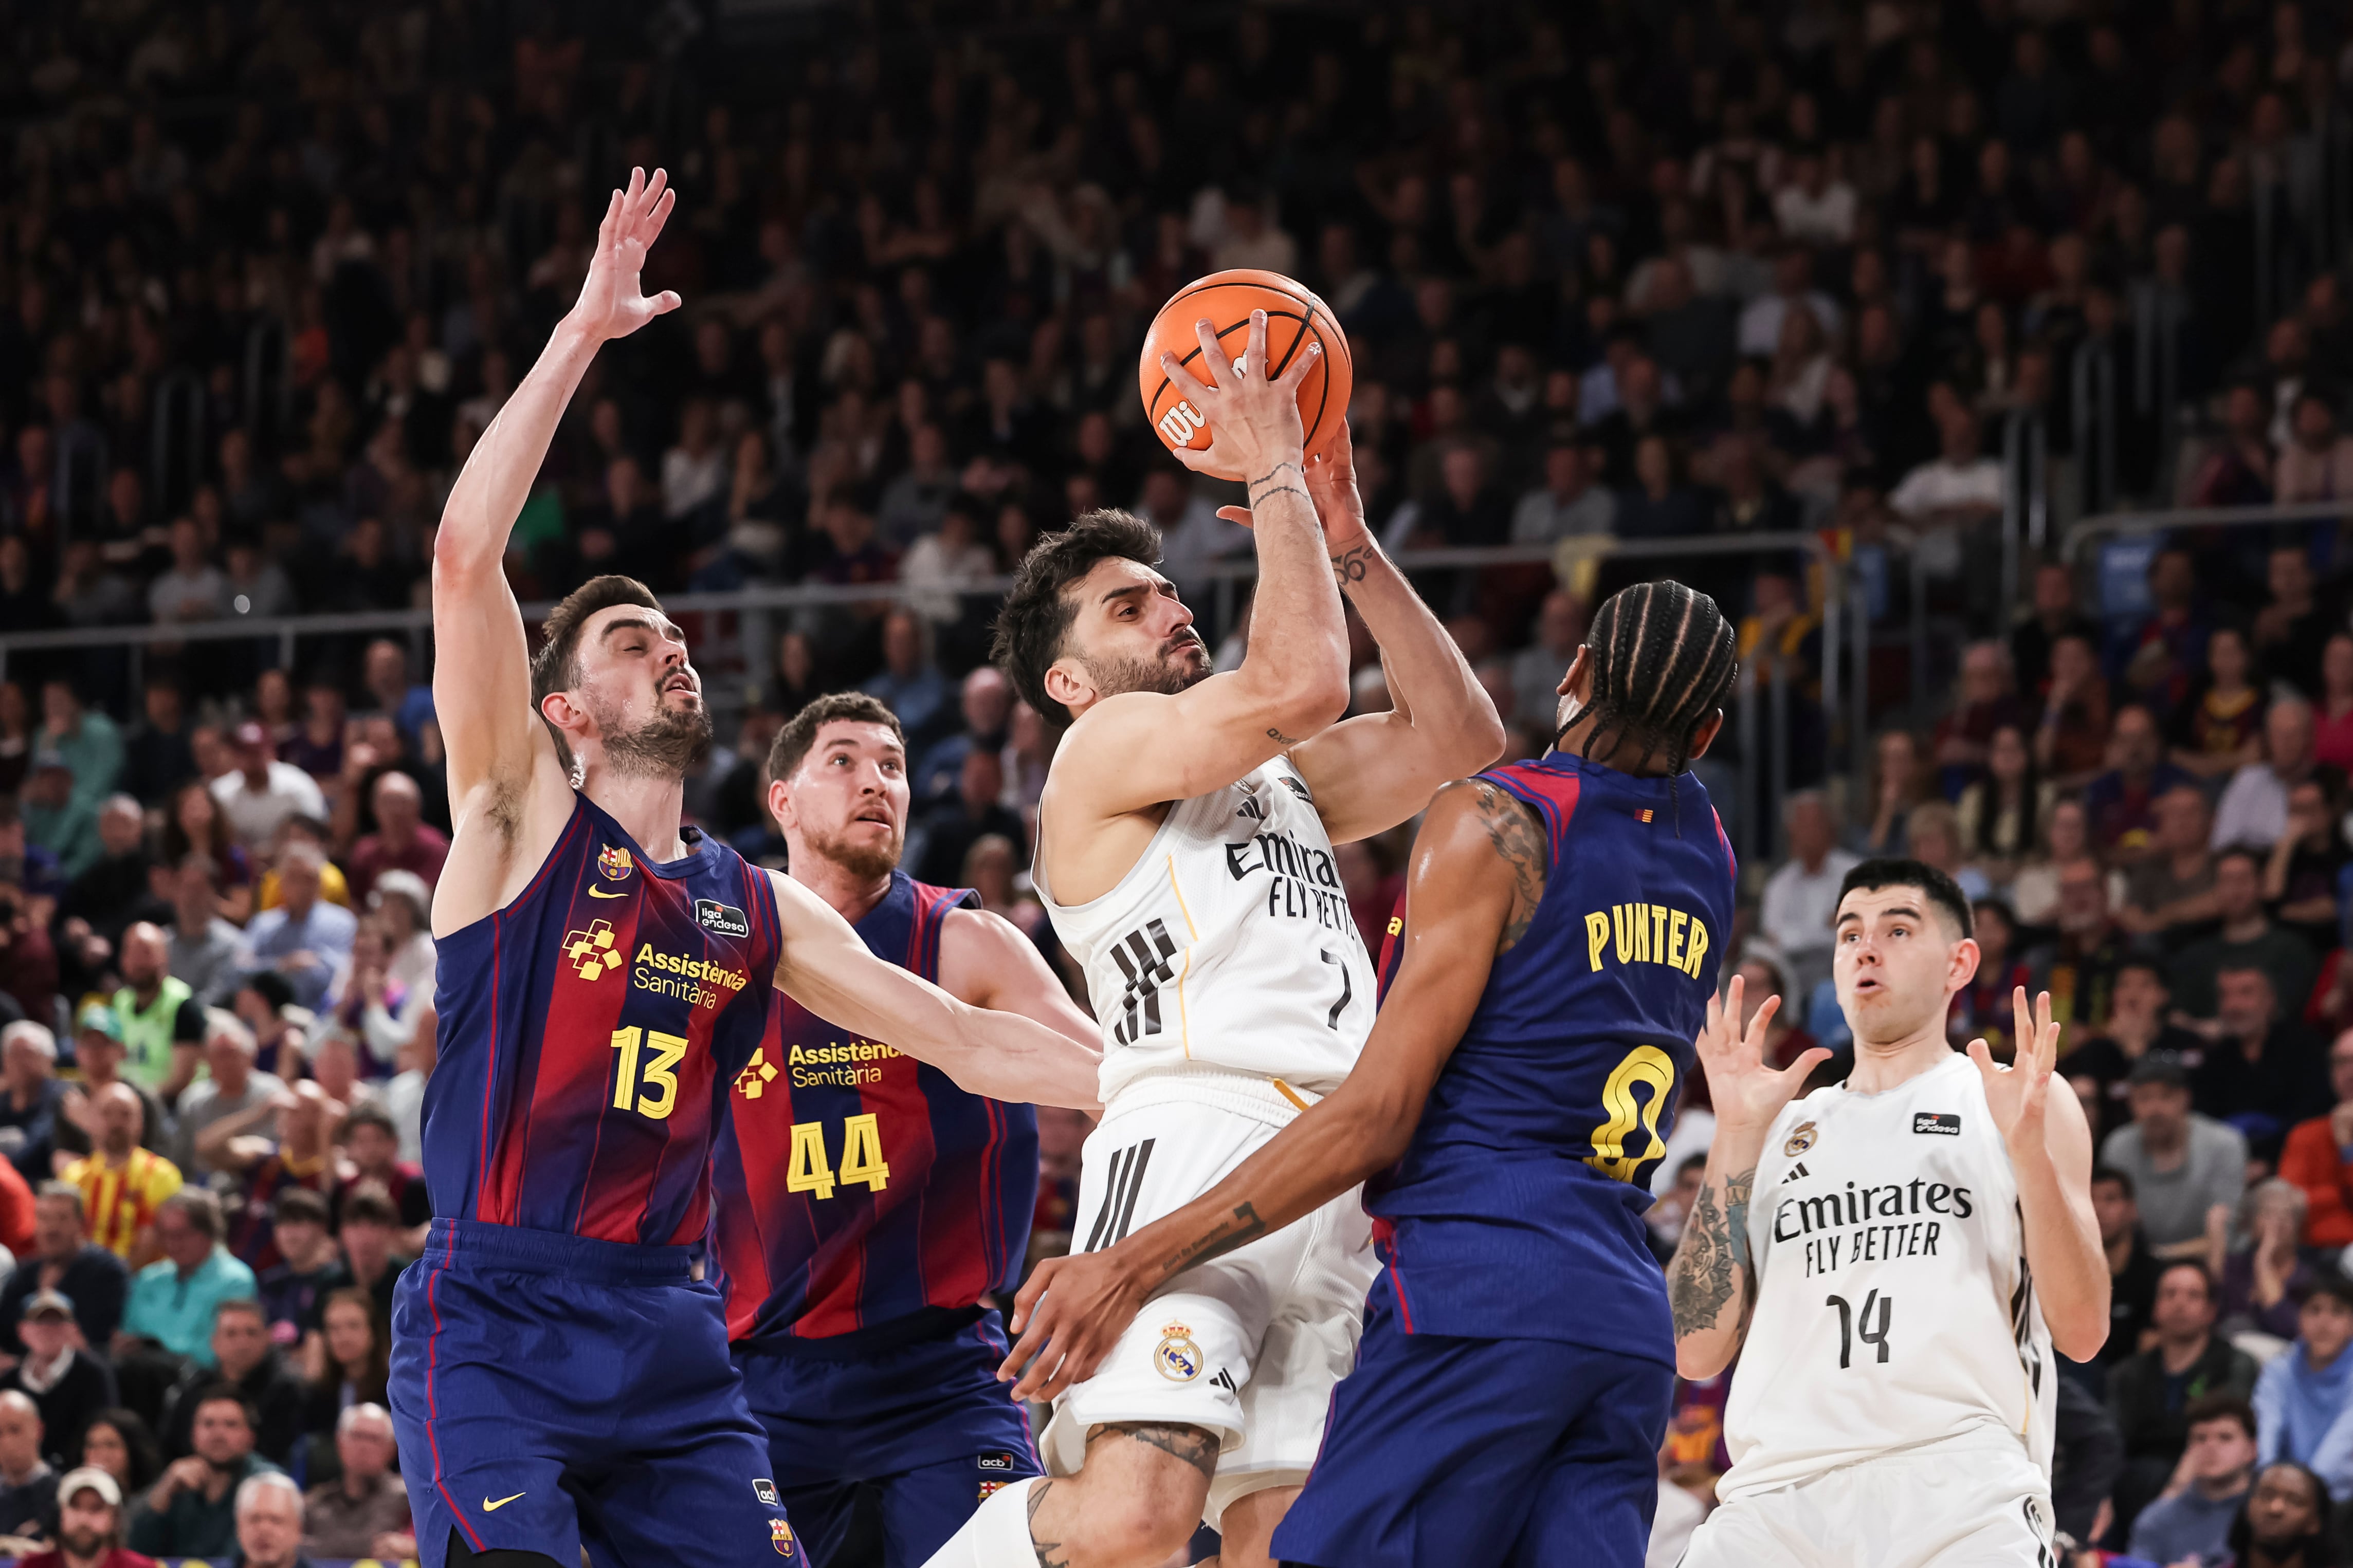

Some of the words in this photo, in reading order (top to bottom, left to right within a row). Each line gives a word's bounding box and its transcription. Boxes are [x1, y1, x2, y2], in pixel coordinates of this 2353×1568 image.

[1225, 829, 1340, 889] Emira
[701, 908, 722, 919] liga
[1269, 876, 1307, 919] FLY
[702, 918, 744, 932] endesa
[1584, 902, 1709, 980] PUNTER
[633, 967, 717, 1010] Sanitària
[635, 943, 747, 991] Assistència
[1320, 948, 1352, 1031] 7
[610, 1025, 689, 1120] 13
[789, 1040, 906, 1066] Assistènc
[791, 1063, 882, 1088] Sanitària
[1582, 1044, 1674, 1184] 0
[786, 1113, 890, 1200] 44
[1774, 1176, 1973, 1243] Emirates
[1805, 1235, 1840, 1278] FLY
[1850, 1221, 1940, 1264] BETTER
[1826, 1288, 1892, 1369] 14
[981, 1459, 1006, 1467] acb
[760, 1489, 776, 1502] acb
